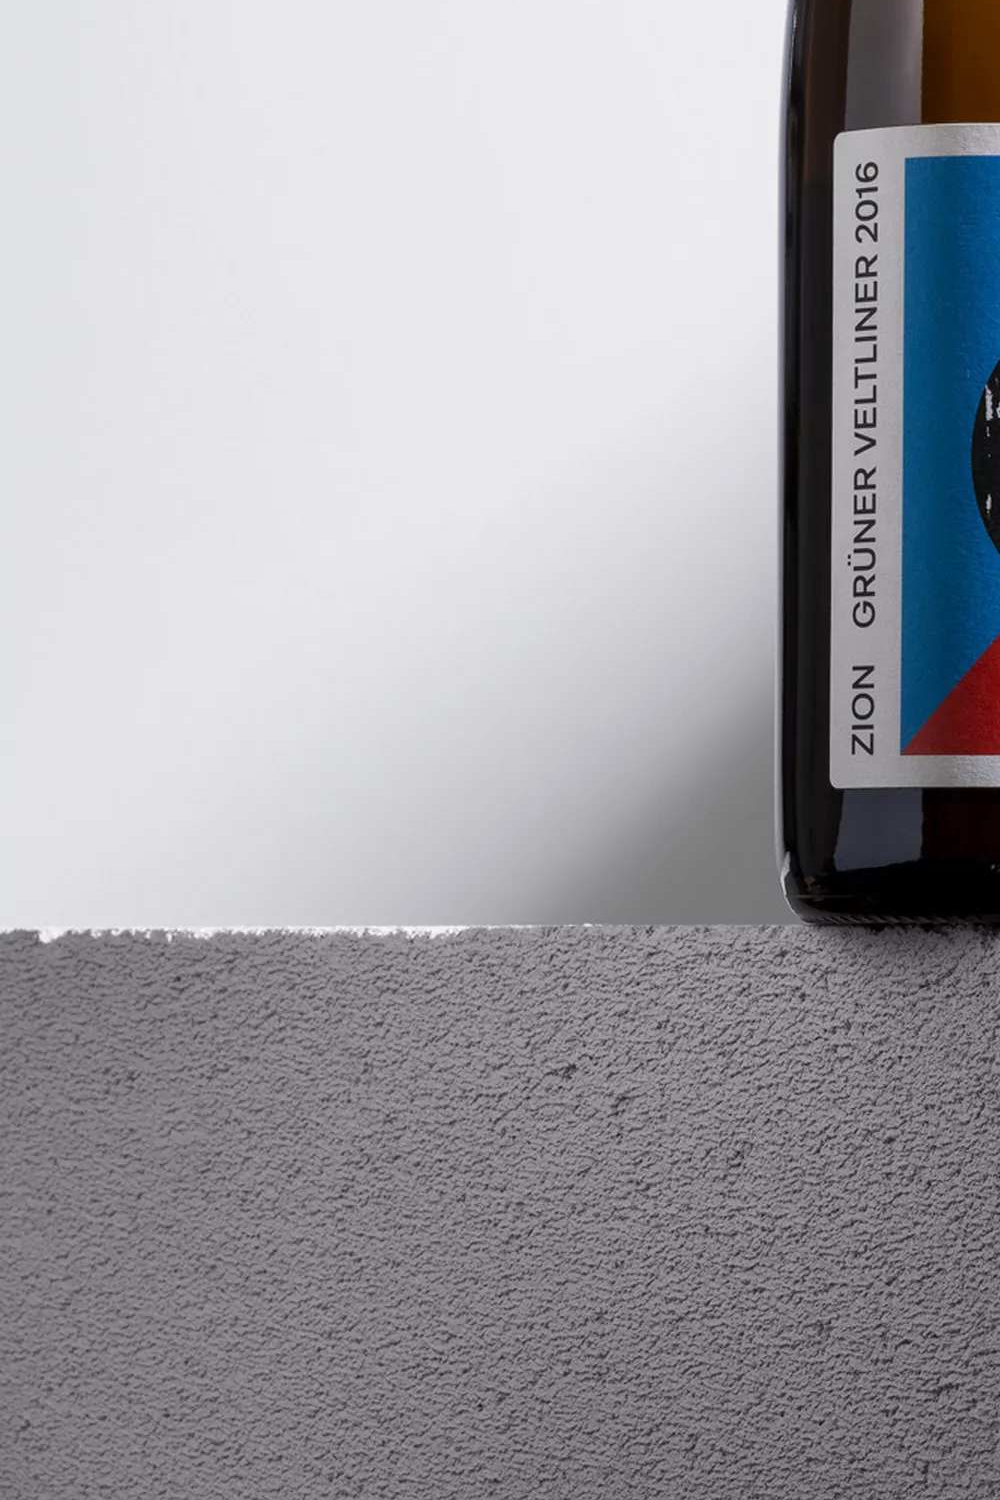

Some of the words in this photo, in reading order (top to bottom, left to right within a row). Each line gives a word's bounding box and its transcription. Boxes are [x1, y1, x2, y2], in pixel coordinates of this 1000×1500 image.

[854, 161, 879, 244] 2016
[853, 253, 879, 457] VELTLINER
[847, 465, 877, 629] GRÜNER
[851, 663, 876, 756] ZION
